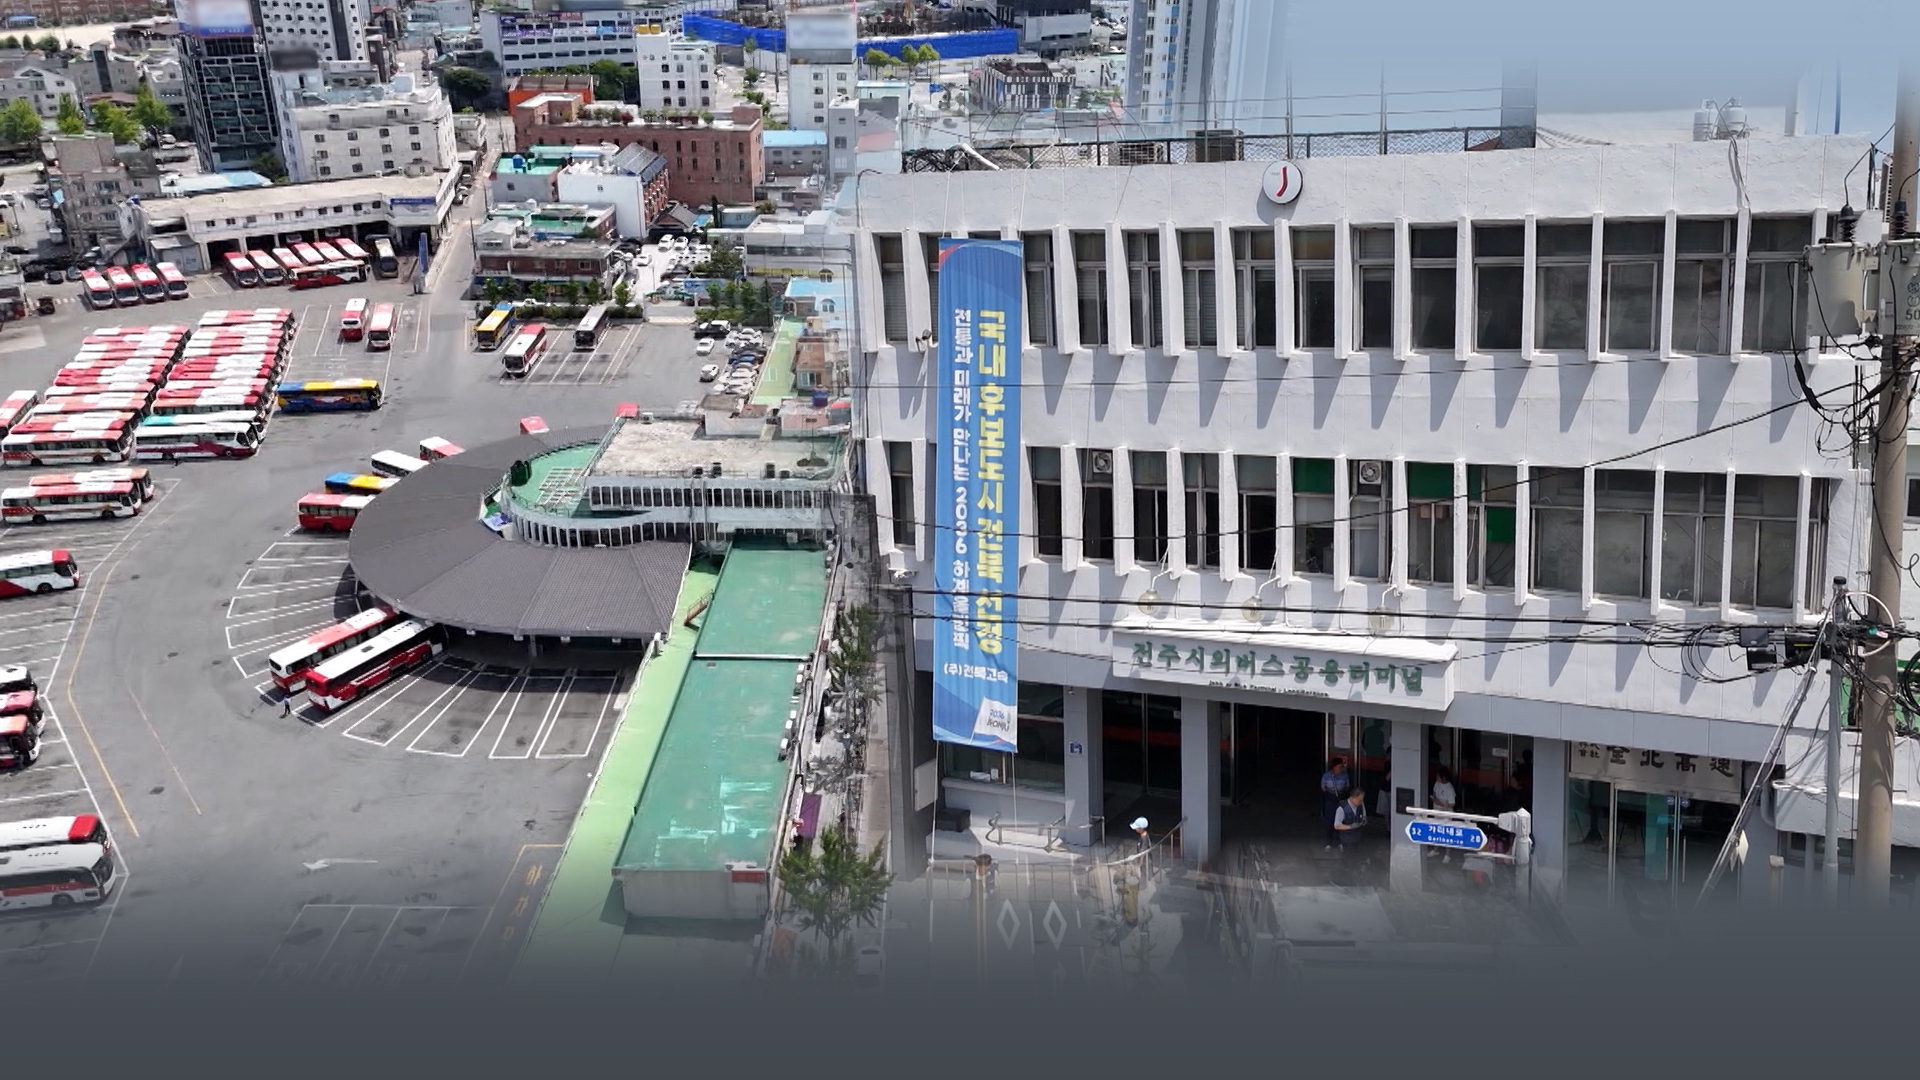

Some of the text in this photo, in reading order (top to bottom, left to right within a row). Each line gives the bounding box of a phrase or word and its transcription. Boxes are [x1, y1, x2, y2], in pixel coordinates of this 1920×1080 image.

[953, 309, 973, 364] 전통과
[953, 370, 972, 422] 미래가
[953, 427, 971, 481] 만나는
[975, 310, 1006, 655] 국내 후보도시 전북 선정
[954, 486, 968, 554] 2036
[1133, 641, 1423, 693] 전주시외버스공용터미널
